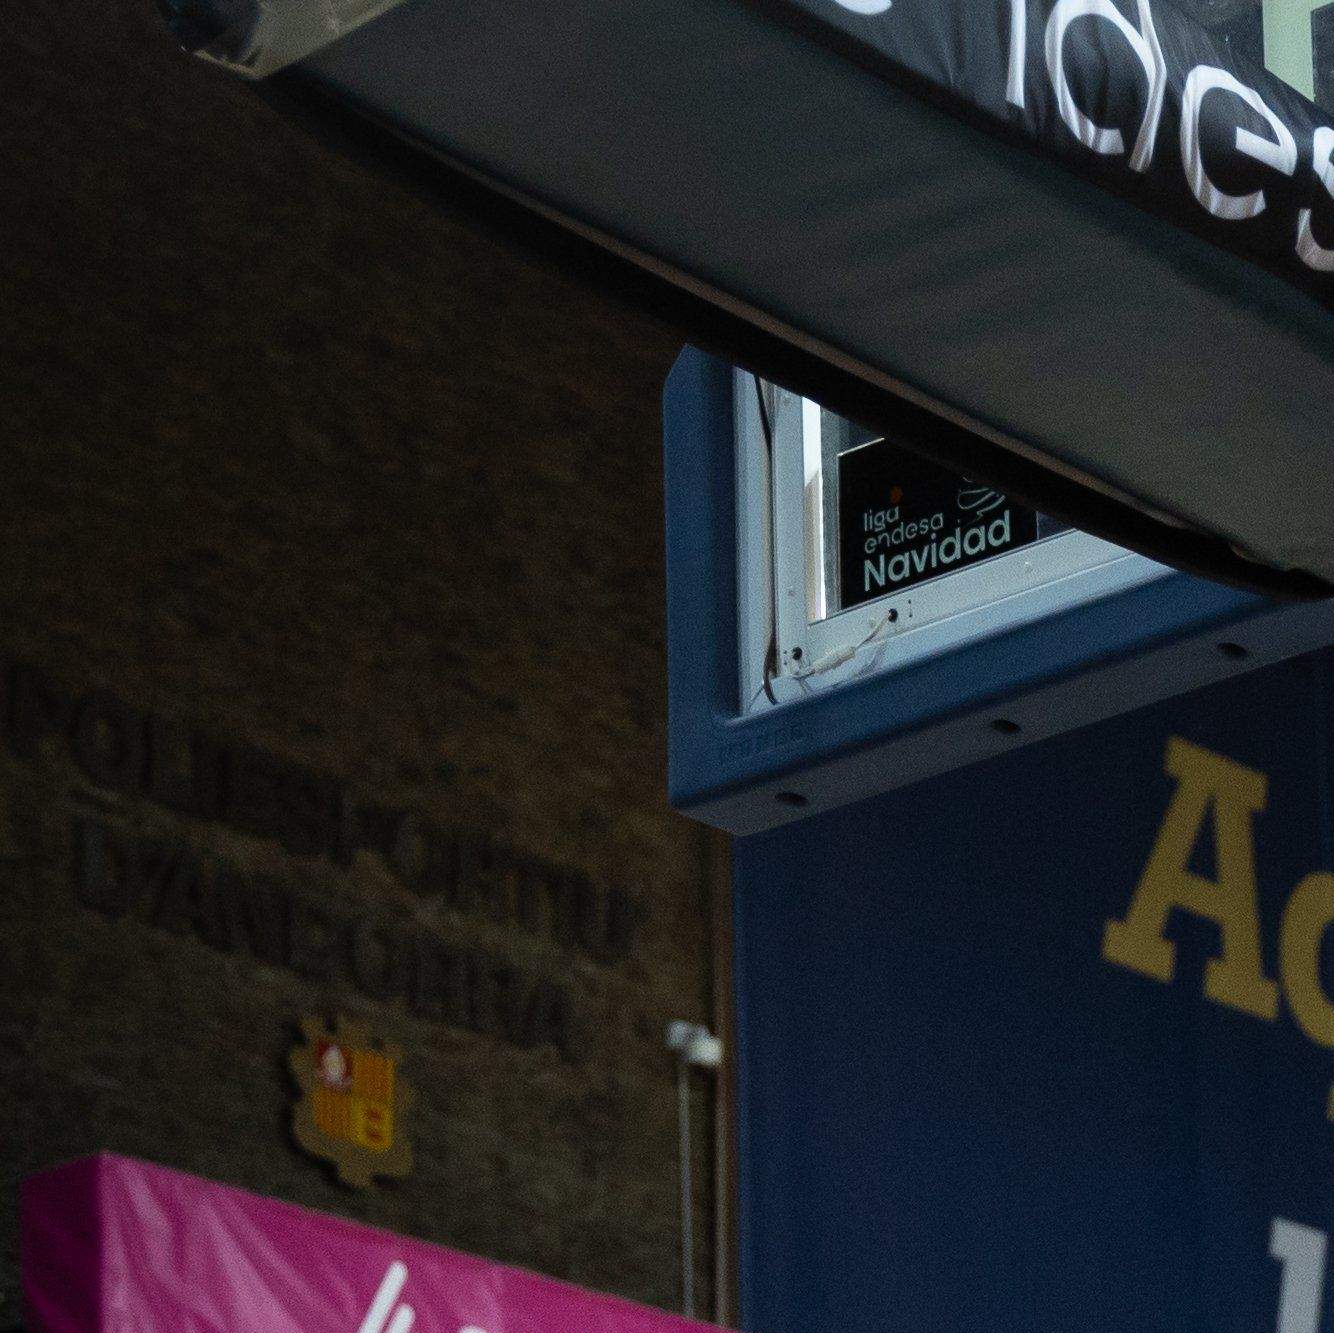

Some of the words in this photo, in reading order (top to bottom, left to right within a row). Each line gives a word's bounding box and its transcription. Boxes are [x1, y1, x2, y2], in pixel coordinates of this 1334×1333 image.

[863, 506, 900, 532] liga
[864, 512, 944, 554] endesa
[863, 509, 1011, 592] Navidad
